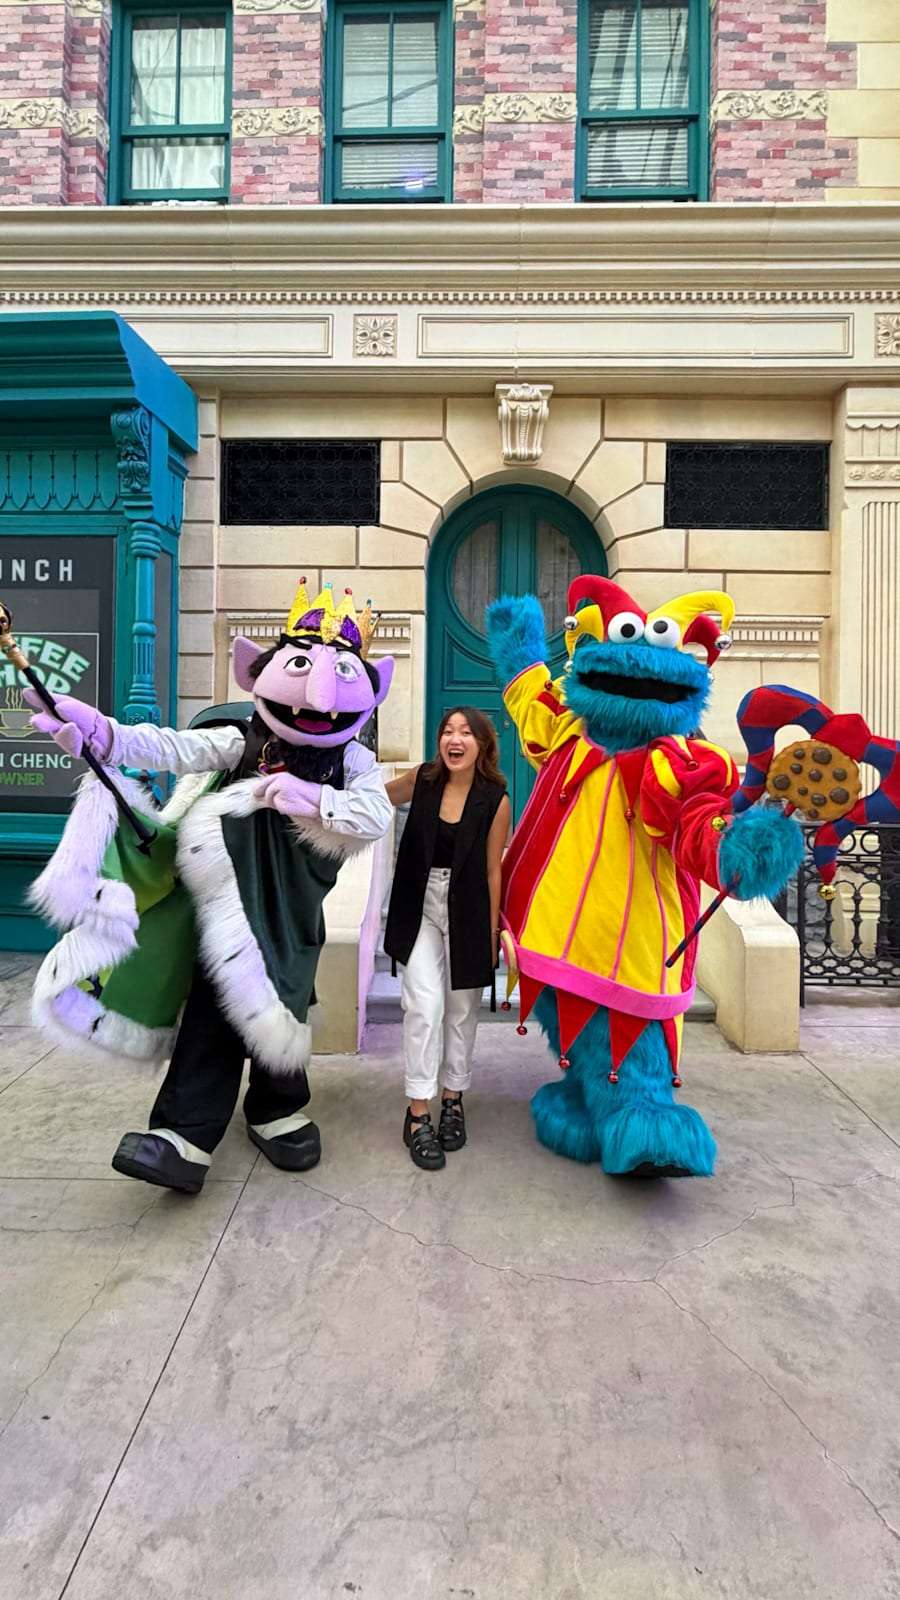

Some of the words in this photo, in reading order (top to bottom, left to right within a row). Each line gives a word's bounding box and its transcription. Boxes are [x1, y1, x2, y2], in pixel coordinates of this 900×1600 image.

[0, 559, 73, 582] NCH
[0, 636, 91, 683] FEE
[10, 753, 72, 769] CHENG
